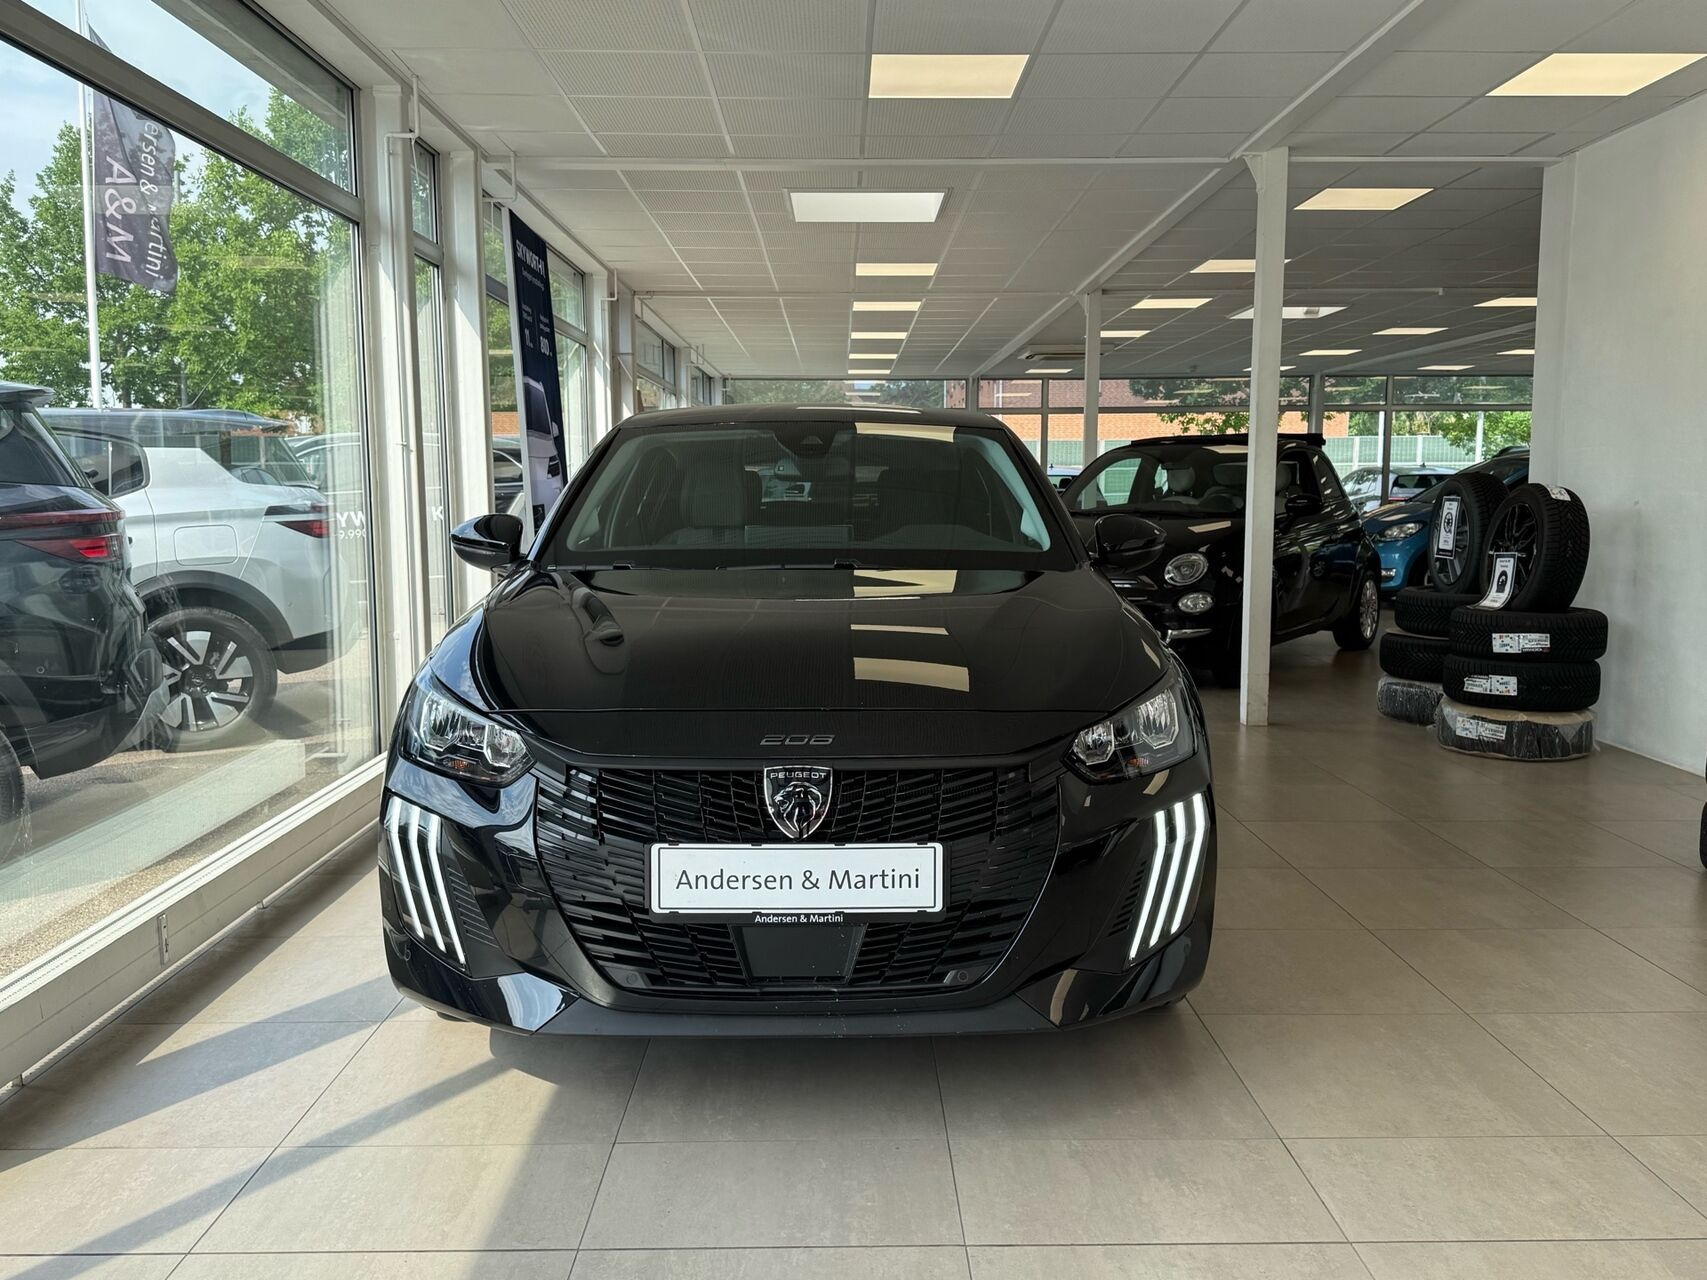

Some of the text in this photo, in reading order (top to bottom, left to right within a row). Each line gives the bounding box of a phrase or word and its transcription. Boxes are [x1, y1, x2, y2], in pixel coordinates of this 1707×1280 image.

[139, 179, 159, 195] &
[104, 155, 138, 264] A&M
[145, 203, 167, 280] artini
[760, 734, 836, 746] 208
[770, 771, 827, 779] PEUGEOT
[675, 868, 920, 890] Andersen & Martini
[754, 914, 843, 924] Andersen & Martini
